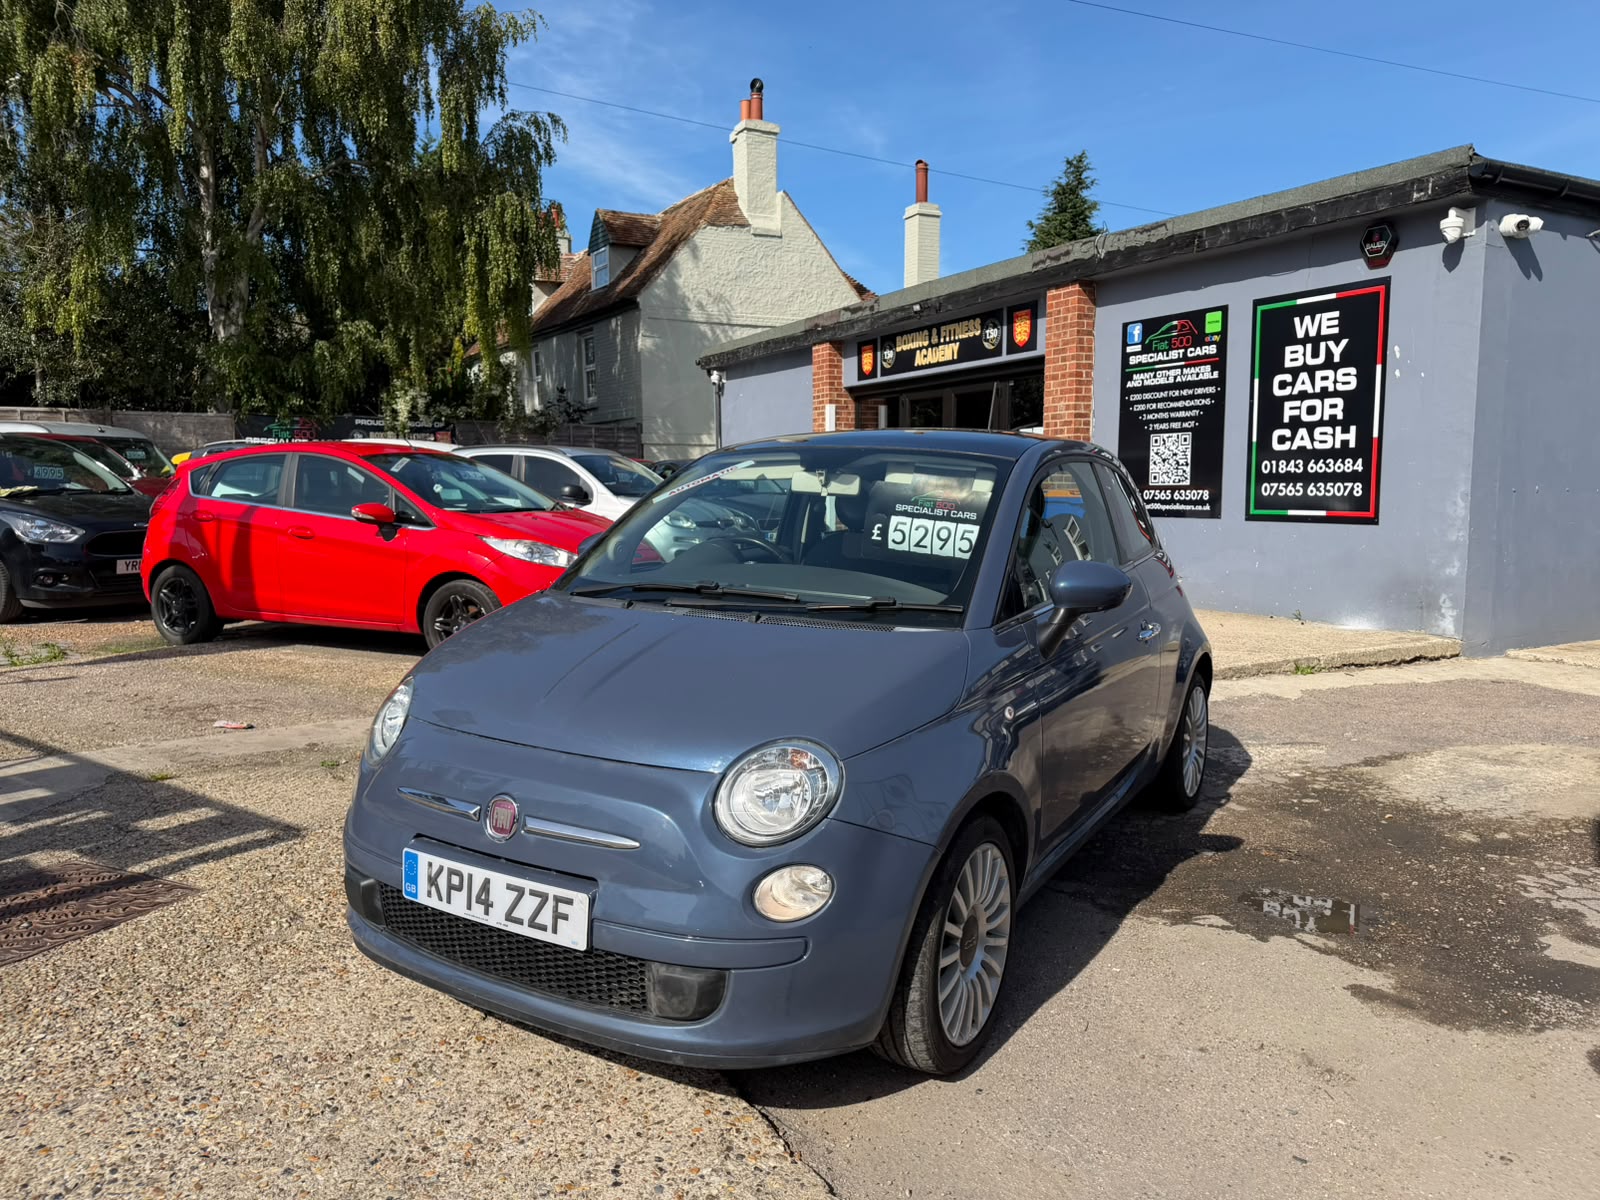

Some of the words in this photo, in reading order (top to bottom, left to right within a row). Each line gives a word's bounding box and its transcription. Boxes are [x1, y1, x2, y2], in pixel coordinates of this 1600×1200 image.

[1293, 310, 1340, 339] WE
[896, 329, 929, 352] BOXING
[931, 327, 938, 344] &
[940, 317, 981, 343] FITNESS
[1152, 339, 1169, 351] Fiat
[1171, 335, 1192, 348] 500
[914, 341, 960, 367] ACADEMY
[1129, 349, 1184, 365] SPECIALIST
[1187, 344, 1217, 357] CARS
[1284, 338, 1349, 368] BUY
[1126, 380, 1142, 388] AND
[1143, 376, 1174, 386] MODELS
[1176, 371, 1219, 383] AVAILABLE
[1133, 371, 1155, 381] MANY
[1156, 368, 1181, 379] OTHER
[1183, 365, 1211, 375] MAKES
[1272, 367, 1357, 396] CARS
[1143, 391, 1168, 400] DISCOUNT
[1169, 390, 1180, 398] FOR
[1180, 388, 1193, 396] NEW
[1194, 386, 1216, 395] DRIVERS
[1146, 402, 1157, 410] FOR
[1157, 398, 1211, 409] RECOMMENDATIONS
[1283, 397, 1344, 423] FOR
[1147, 411, 1169, 420] MONTHS
[1170, 410, 1199, 418] WARRANTY
[272, 428, 291, 438] Fiat
[294, 428, 316, 439] 500
[1170, 421, 1181, 429] FREE
[1272, 425, 1356, 451] CASH
[35, 466, 64, 479] 4995
[1261, 459, 1304, 474] 01843
[1307, 457, 1363, 473] 663684
[668, 466, 737, 496] AUTOMATIC
[1261, 482, 1304, 497] 07565
[1307, 482, 1363, 497] 635078
[1143, 489, 1171, 500] 07565
[1173, 489, 1209, 500] 635078
[895, 503, 948, 517] SPECIALIST
[950, 510, 977, 520] CARS
[918, 499, 934, 508] Fiat
[936, 501, 956, 510] 500
[891, 521, 974, 554] 5295
[493, 806, 513, 829] FIAT
[405, 882, 416, 894] GB
[427, 861, 494, 916] KP14
[504, 882, 574, 935] ZZF
